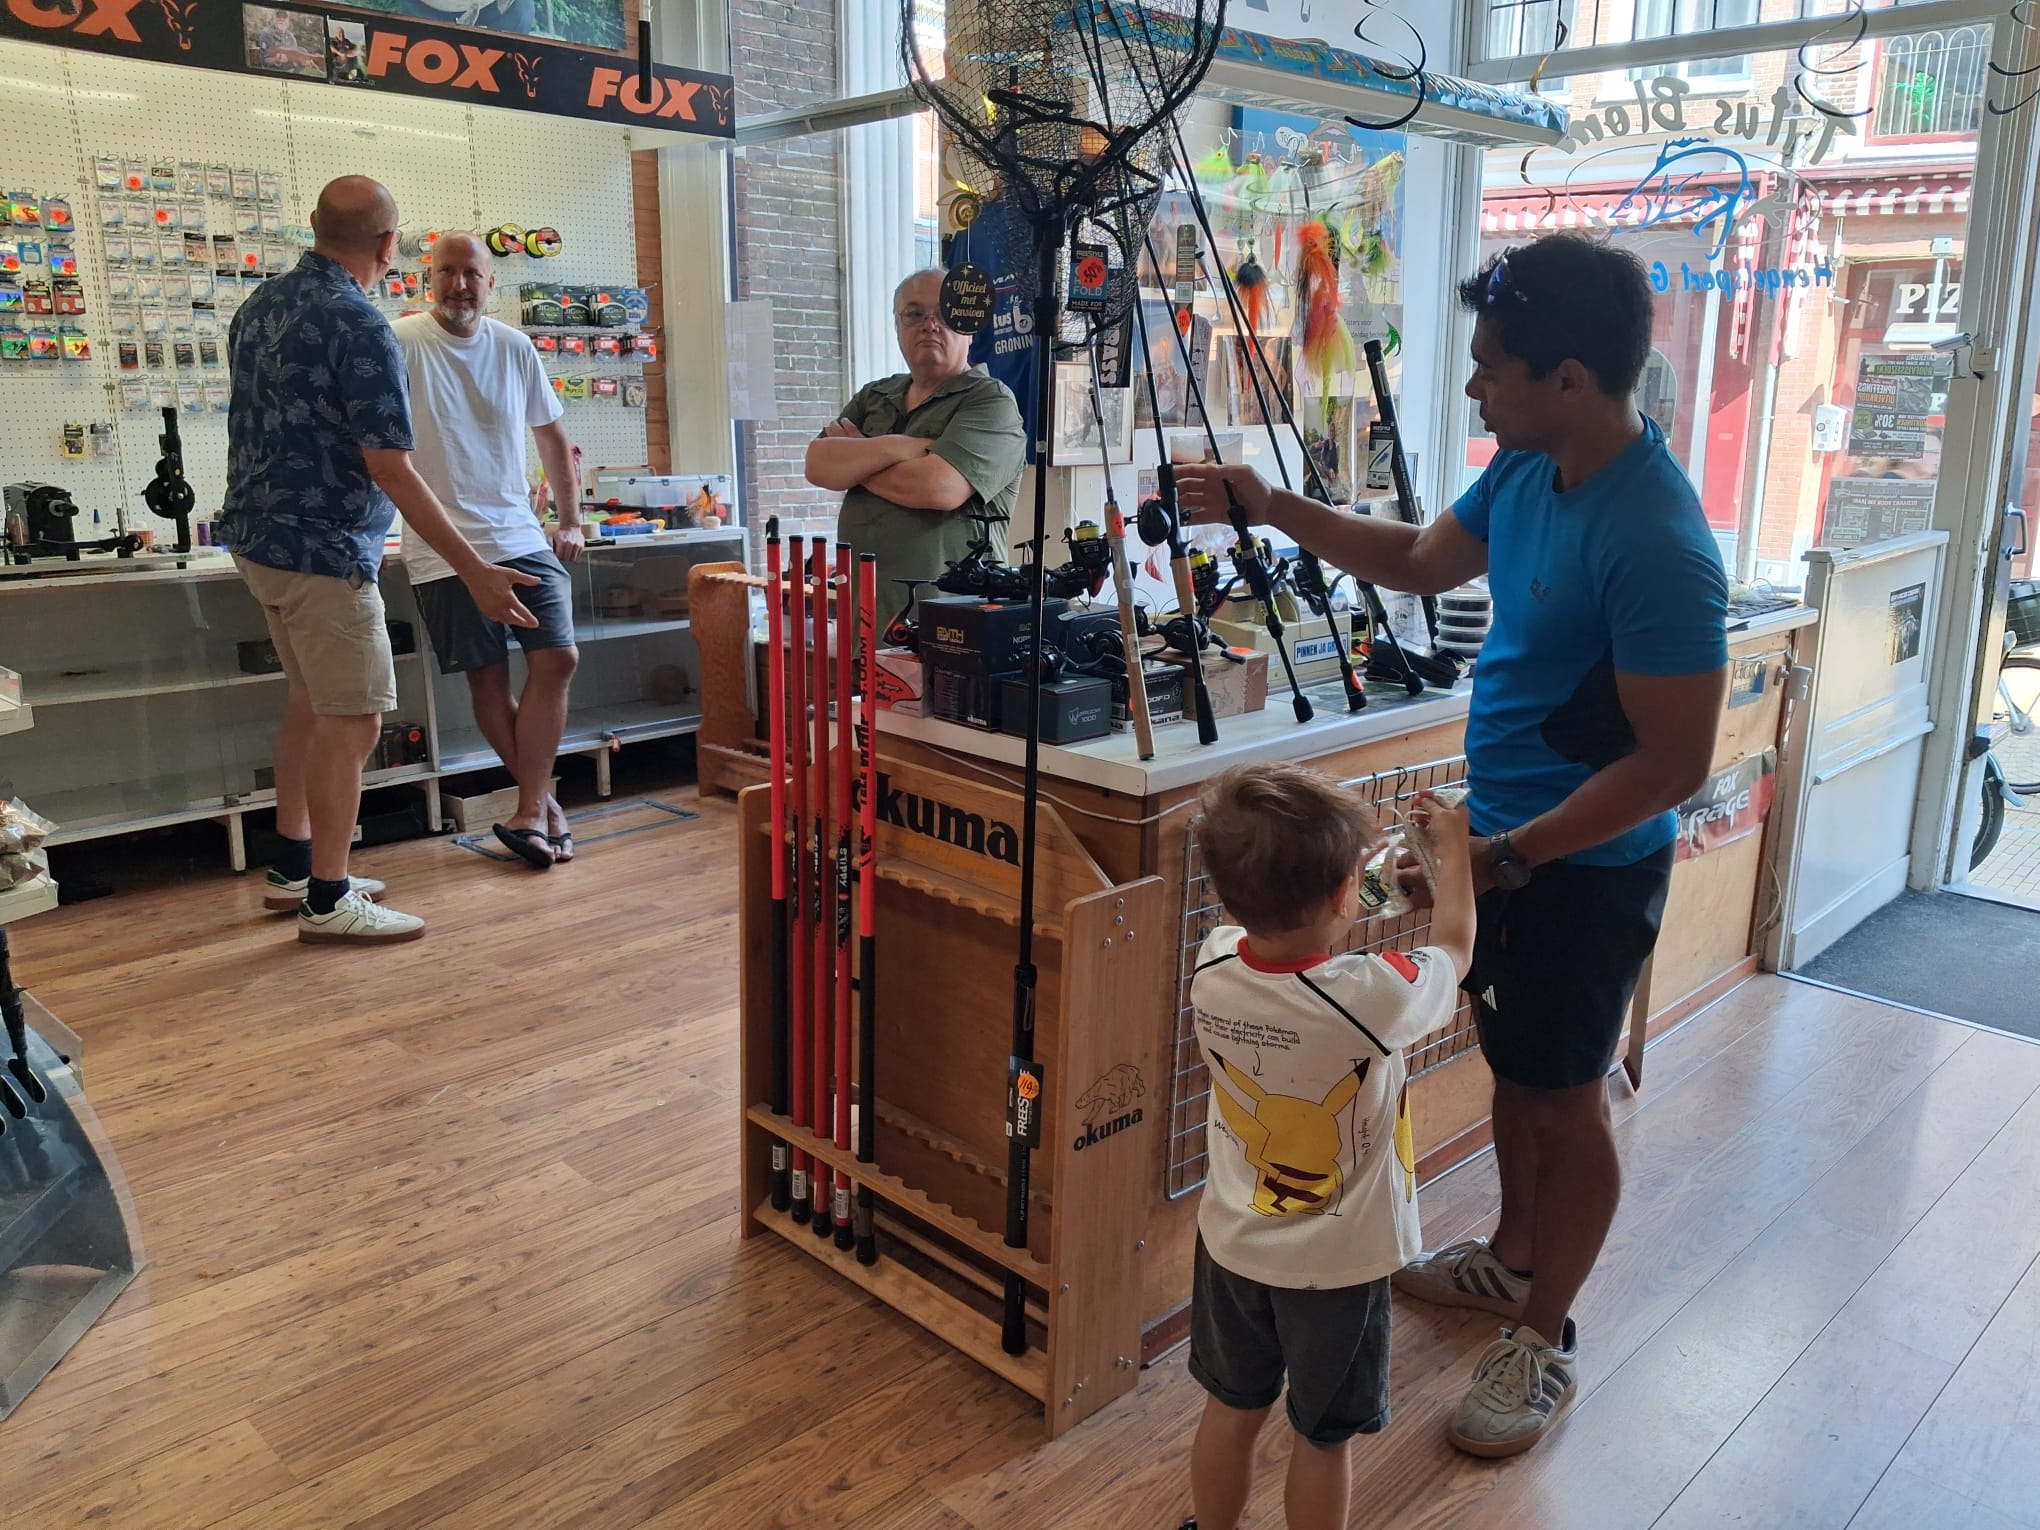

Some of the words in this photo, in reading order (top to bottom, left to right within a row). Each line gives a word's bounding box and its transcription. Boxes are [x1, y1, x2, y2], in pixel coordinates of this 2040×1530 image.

[7, 0, 142, 42] OX
[367, 31, 506, 93] FOX
[587, 66, 703, 122] FOX
[1073, 285, 1102, 297] FOLD
[950, 306, 985, 319] pensioen
[994, 333, 1033, 354] GRONIN
[1296, 643, 1318, 659] PINNEN
[1319, 642, 1327, 654] JA
[1713, 771, 1740, 799] FOX
[1243, 1021, 1263, 1031] these
[1231, 1033, 1260, 1049] lightning
[1017, 1068, 1030, 1137] FREESE
[1073, 1107, 1144, 1151] okuma
